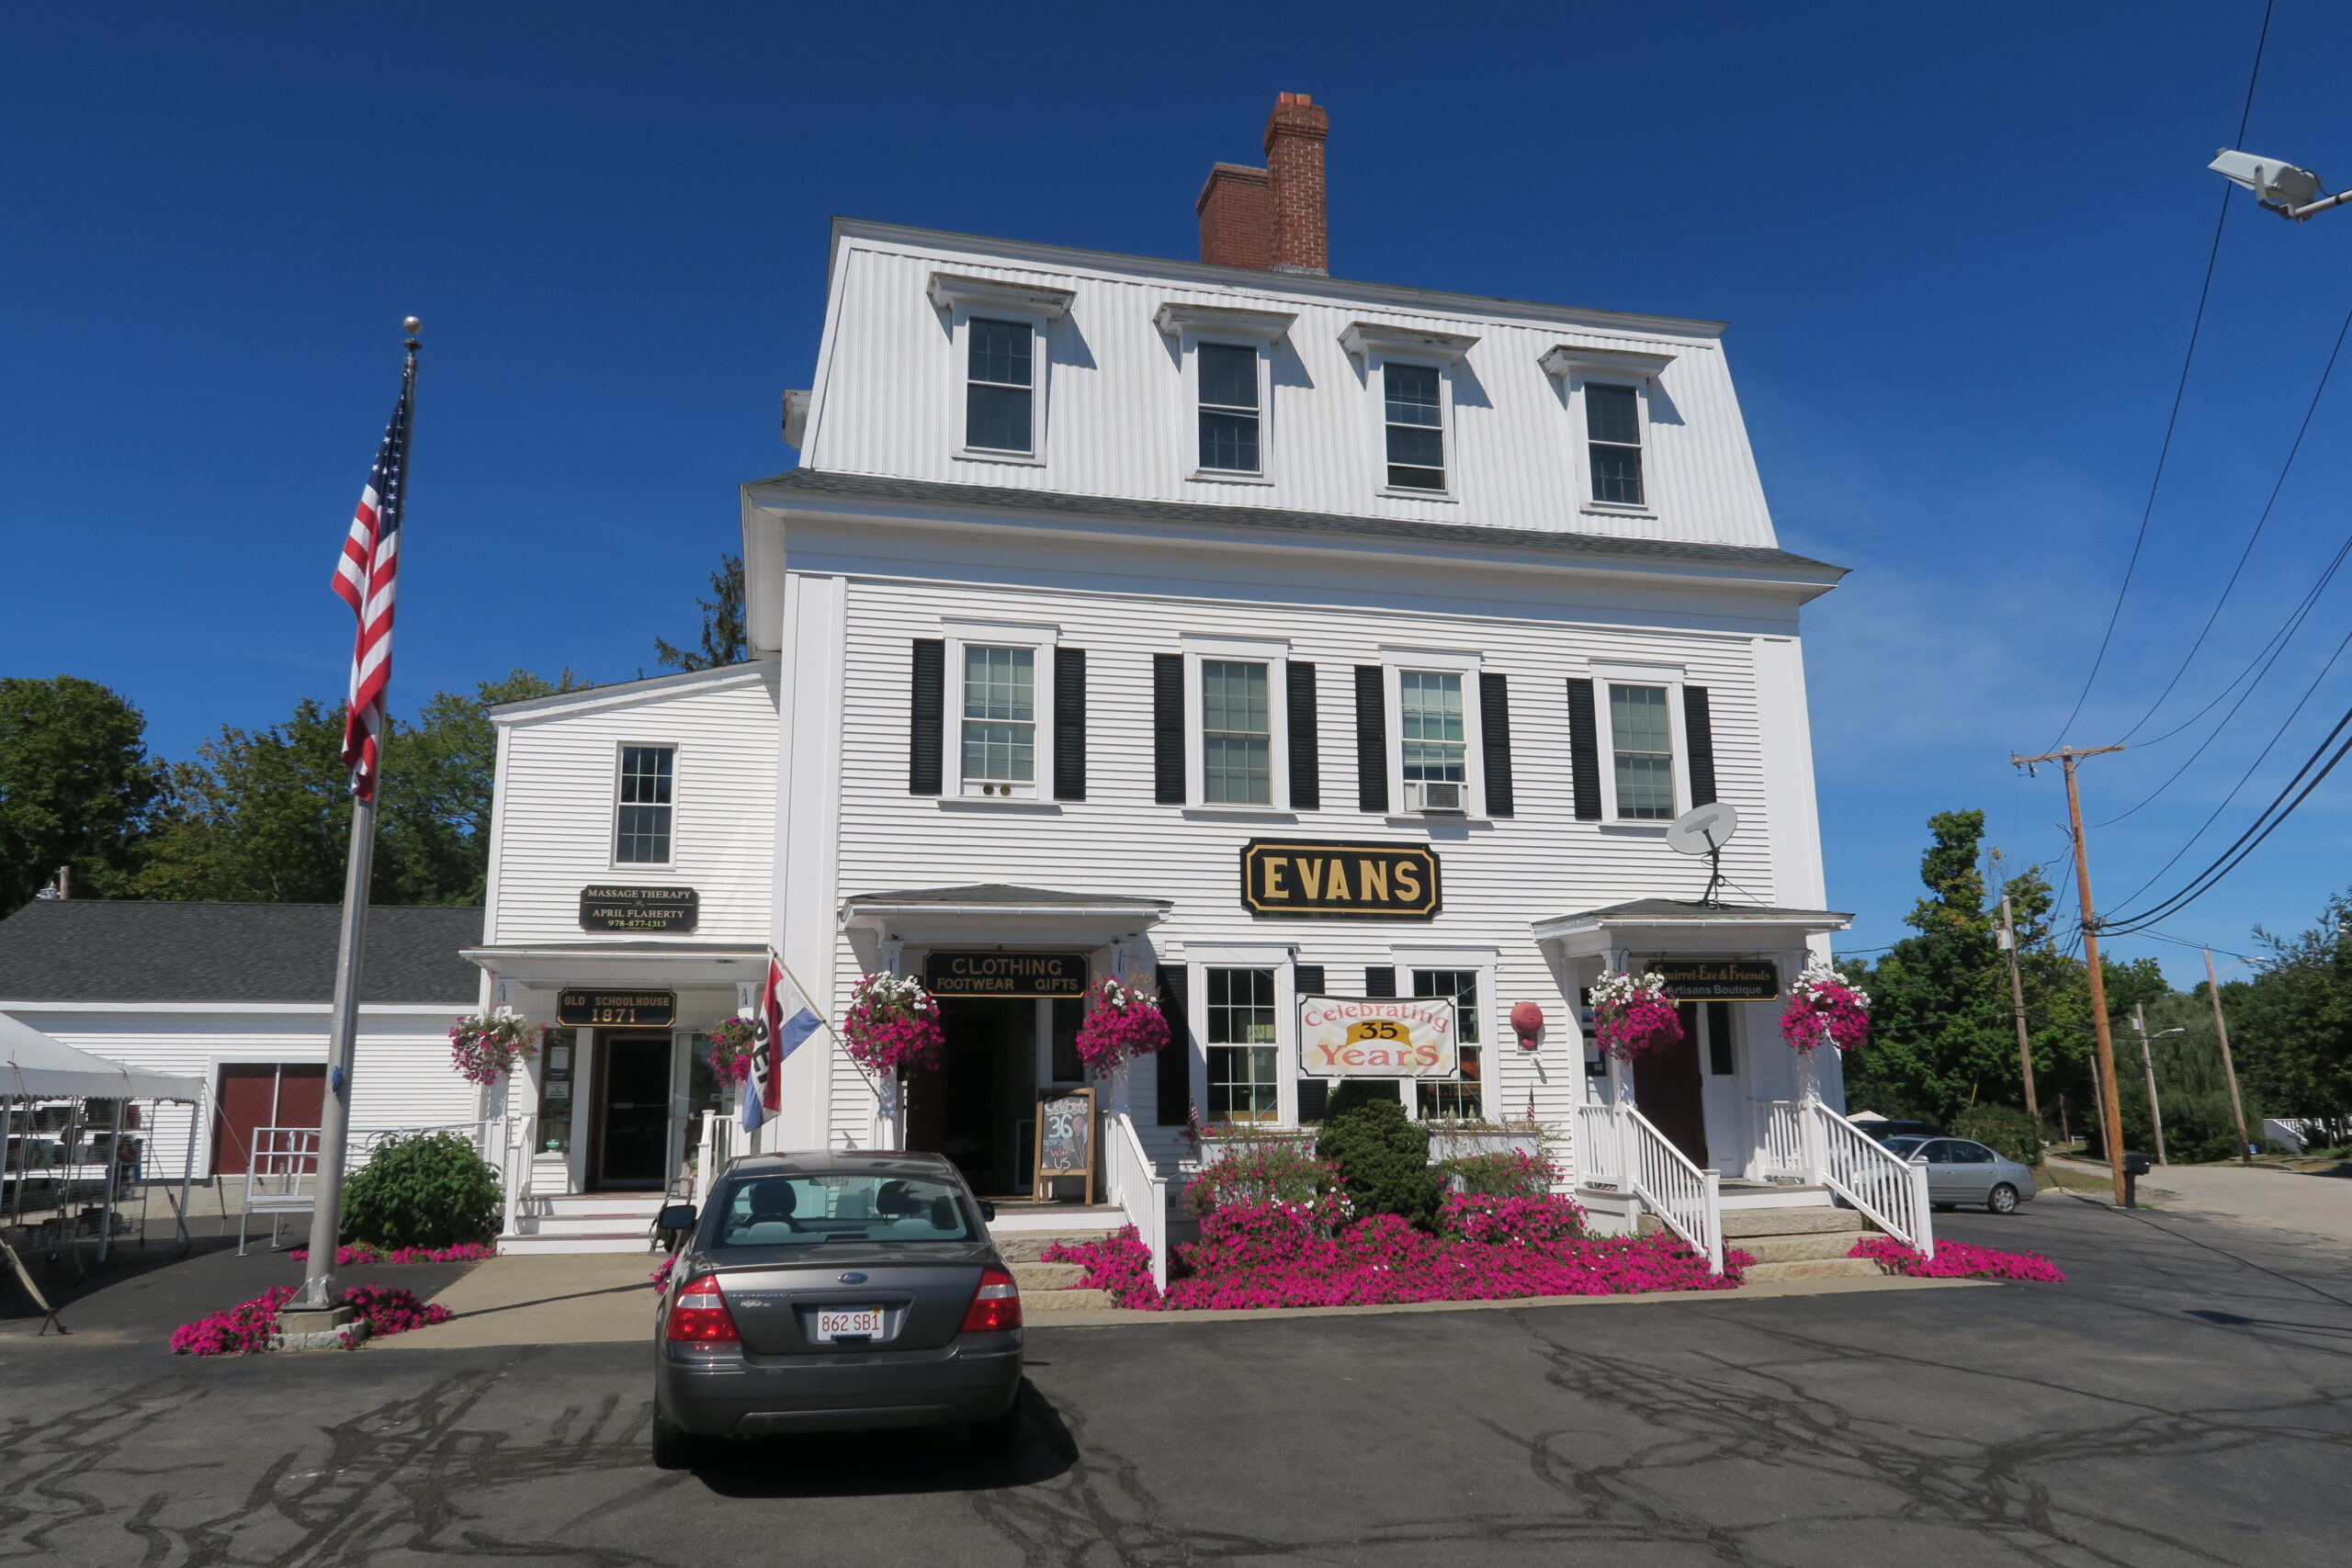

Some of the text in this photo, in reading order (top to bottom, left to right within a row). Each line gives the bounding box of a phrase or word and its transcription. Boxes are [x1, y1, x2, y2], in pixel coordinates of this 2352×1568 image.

[1262, 857, 1420, 902] EVANS
[588, 889, 691, 899] MASSAGE THERAPY
[593, 908, 684, 919] APRIL FLAHERTY
[607, 919, 667, 928] 978-877-1313
[952, 958, 1062, 976] CLOTHING
[1729, 964, 1770, 980] Friends
[937, 977, 1079, 991] FOOTWEAR GIFTS
[1713, 985, 1762, 996] Boutique
[564, 996, 670, 1007] OLD SCHOOLHOUSE
[592, 1009, 637, 1022] 1871
[1305, 1002, 1450, 1033] Celebrating
[1360, 1022, 1398, 1039] 35
[1048, 1113, 1073, 1139] 36
[1044, 1138, 1063, 1151] years
[822, 1314, 879, 1332] 862 SB1
